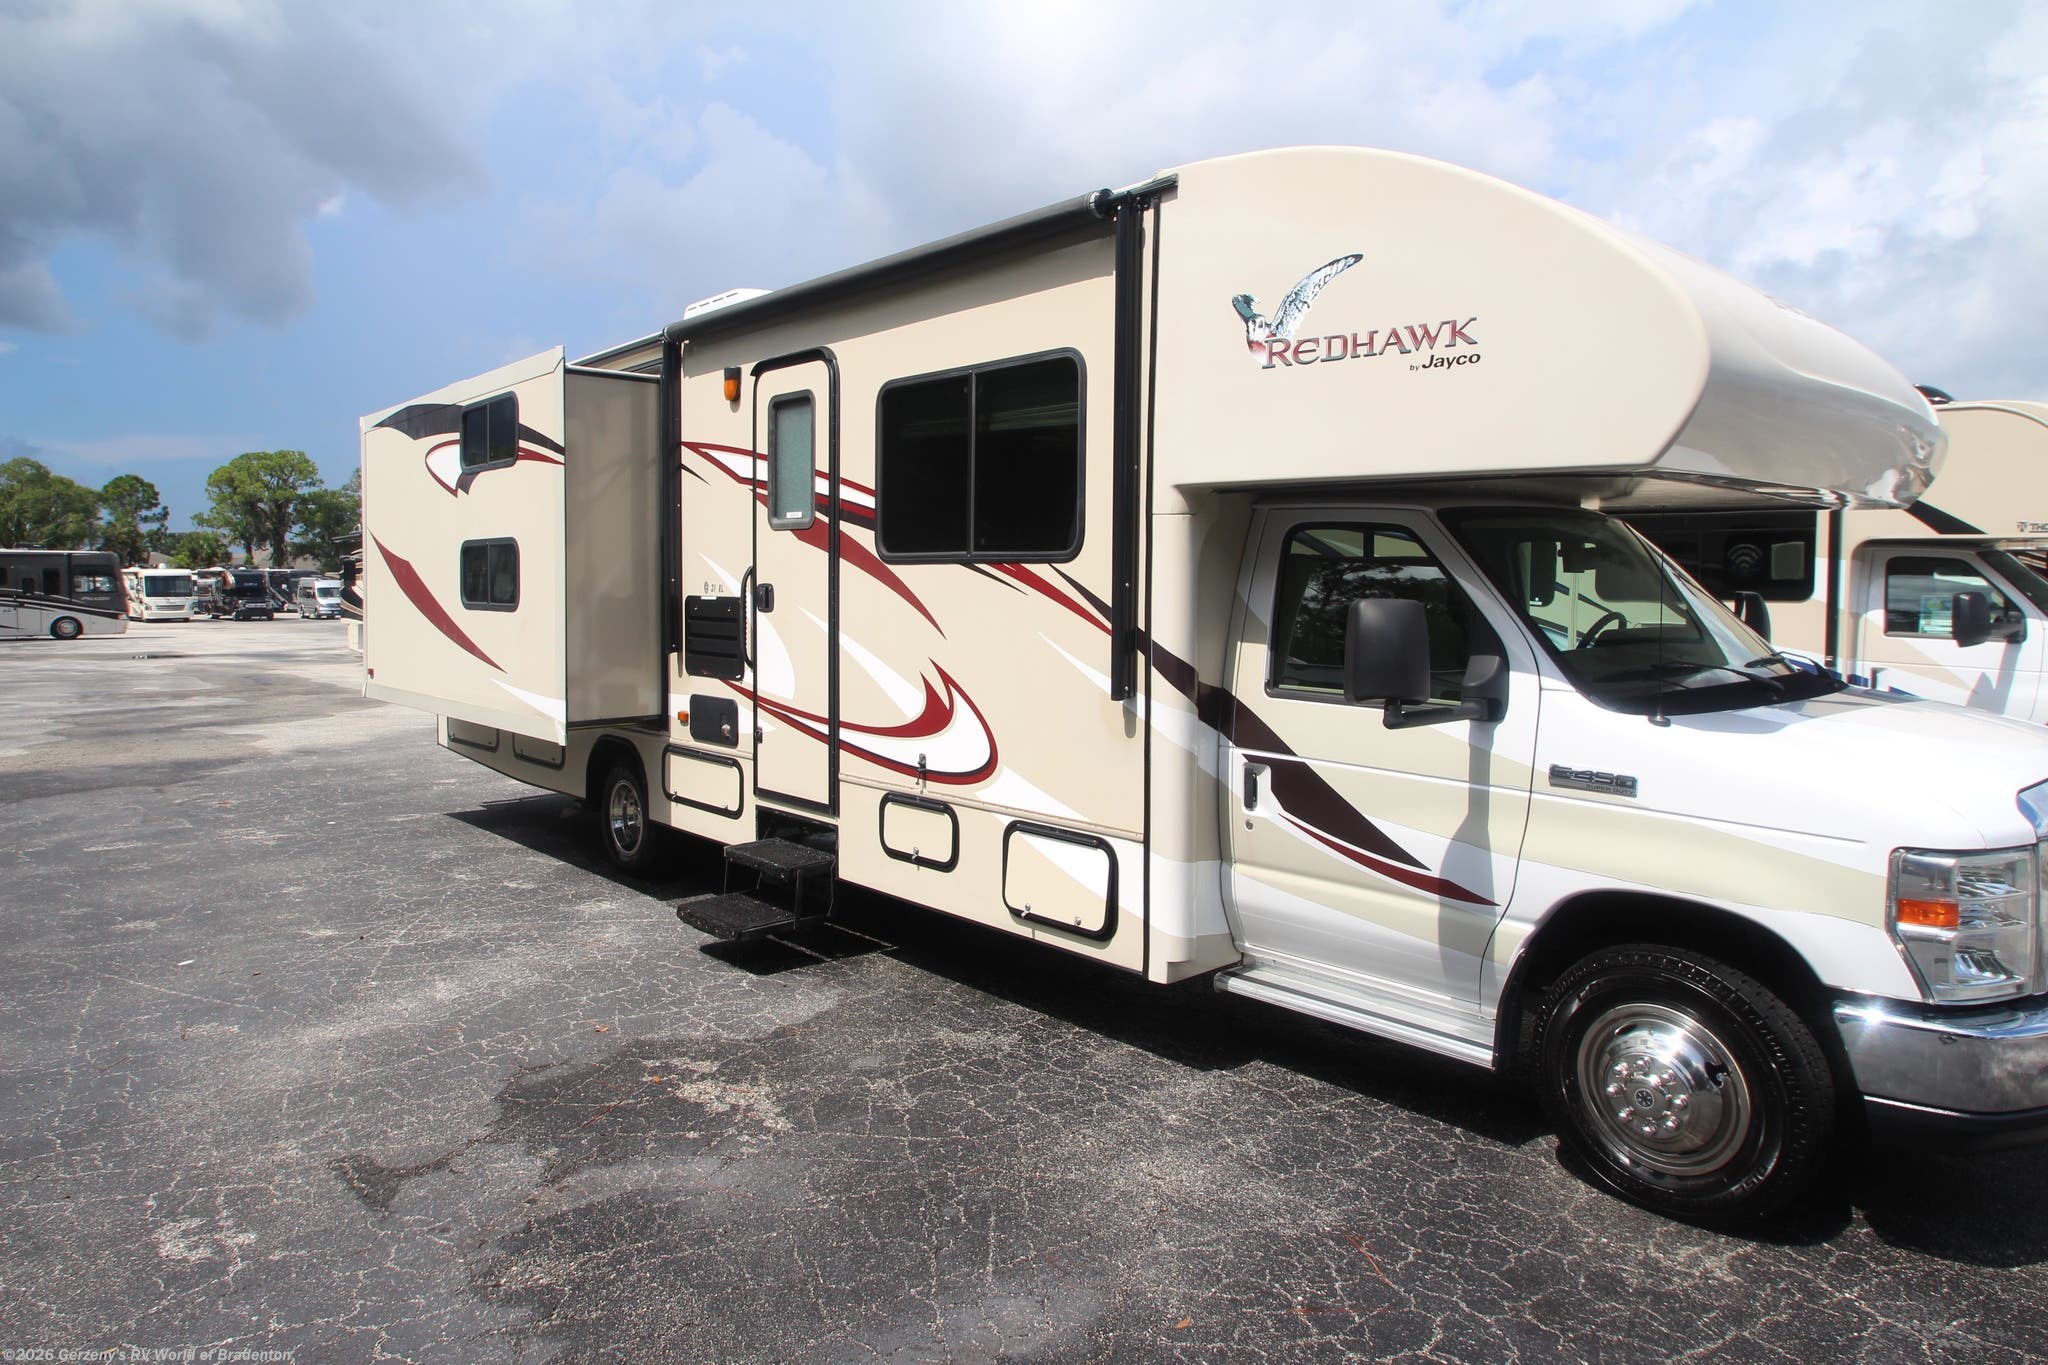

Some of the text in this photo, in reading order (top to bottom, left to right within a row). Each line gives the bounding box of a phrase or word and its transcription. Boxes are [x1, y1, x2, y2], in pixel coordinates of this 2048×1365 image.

[1261, 317, 1478, 369] REDHAWK
[1409, 353, 1481, 372] by Jayco
